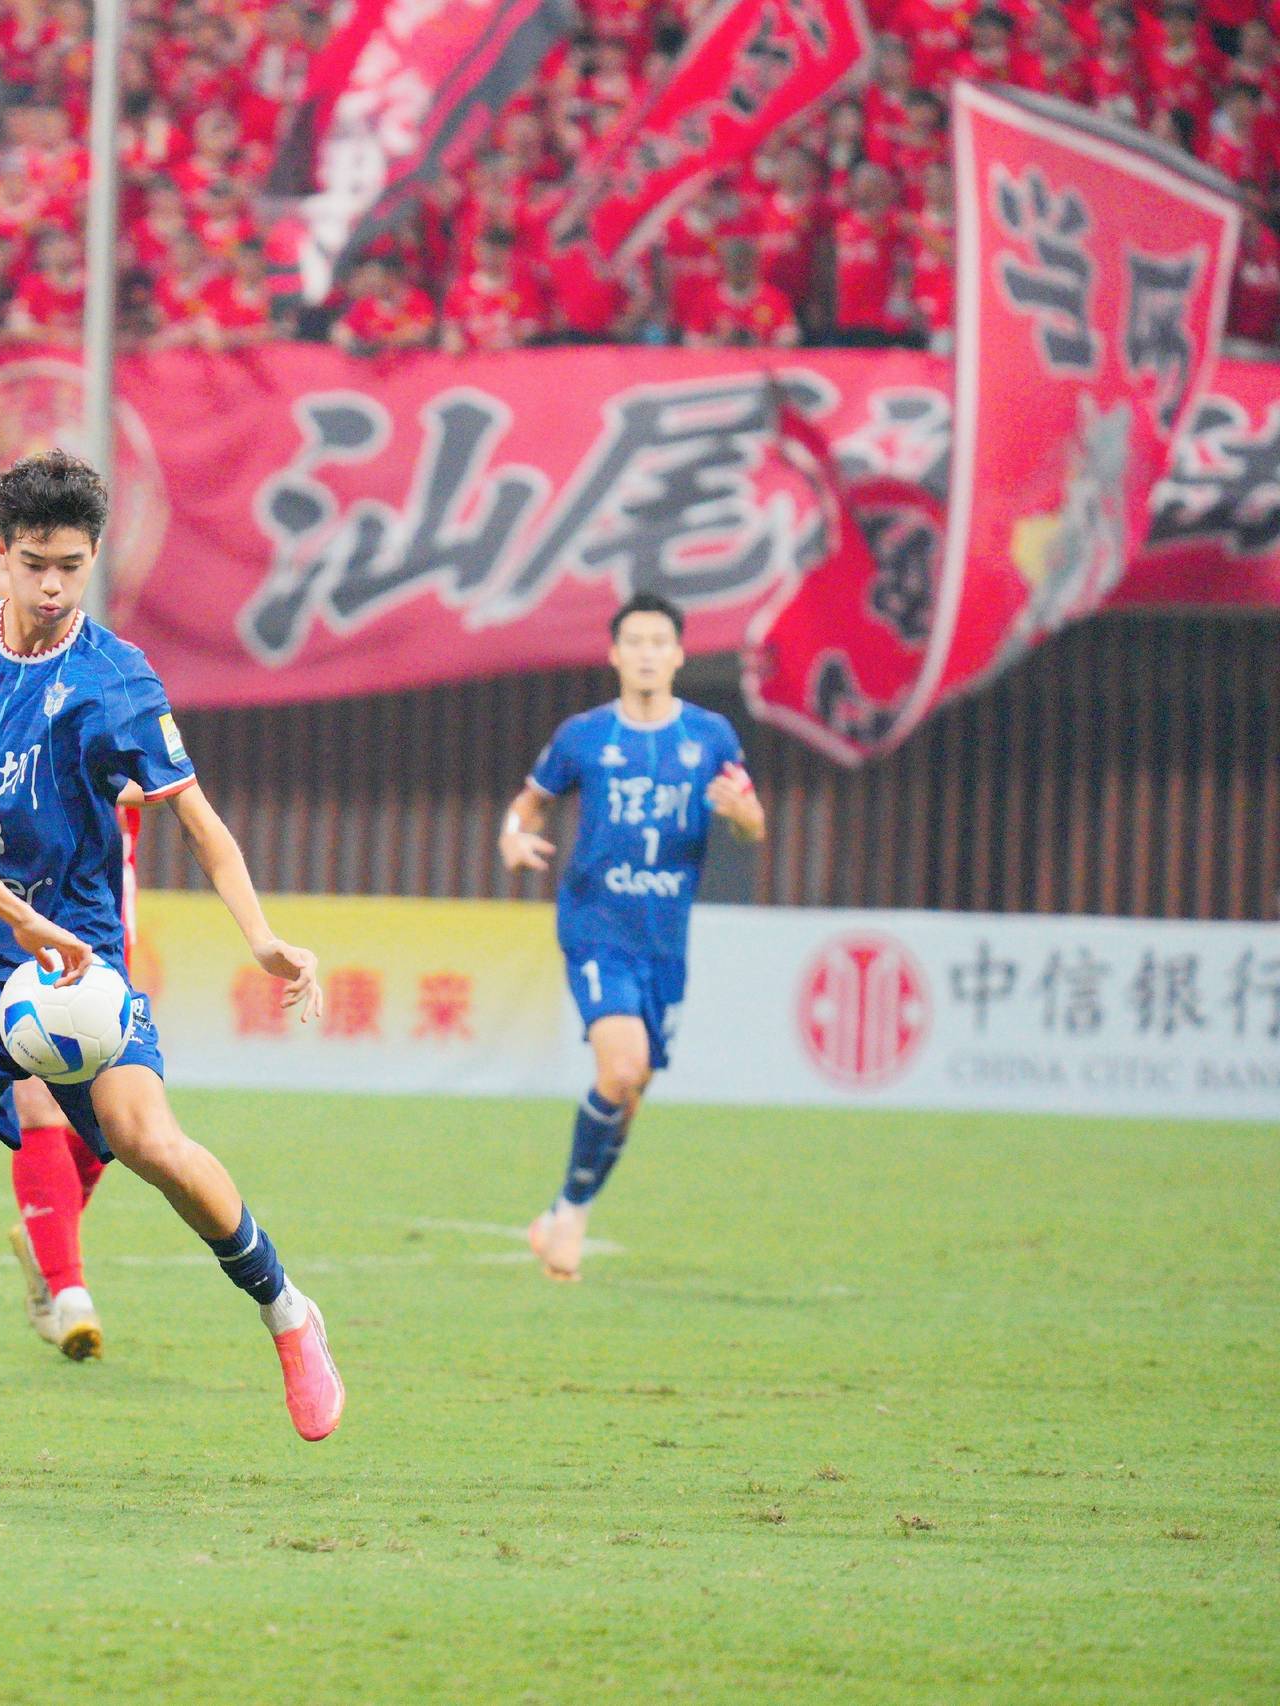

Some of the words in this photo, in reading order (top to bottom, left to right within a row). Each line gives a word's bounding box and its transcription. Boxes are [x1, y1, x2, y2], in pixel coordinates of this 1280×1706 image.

[641, 827, 660, 865] 1
[581, 959, 602, 1003] 1
[950, 938, 1280, 1040] 中信银行
